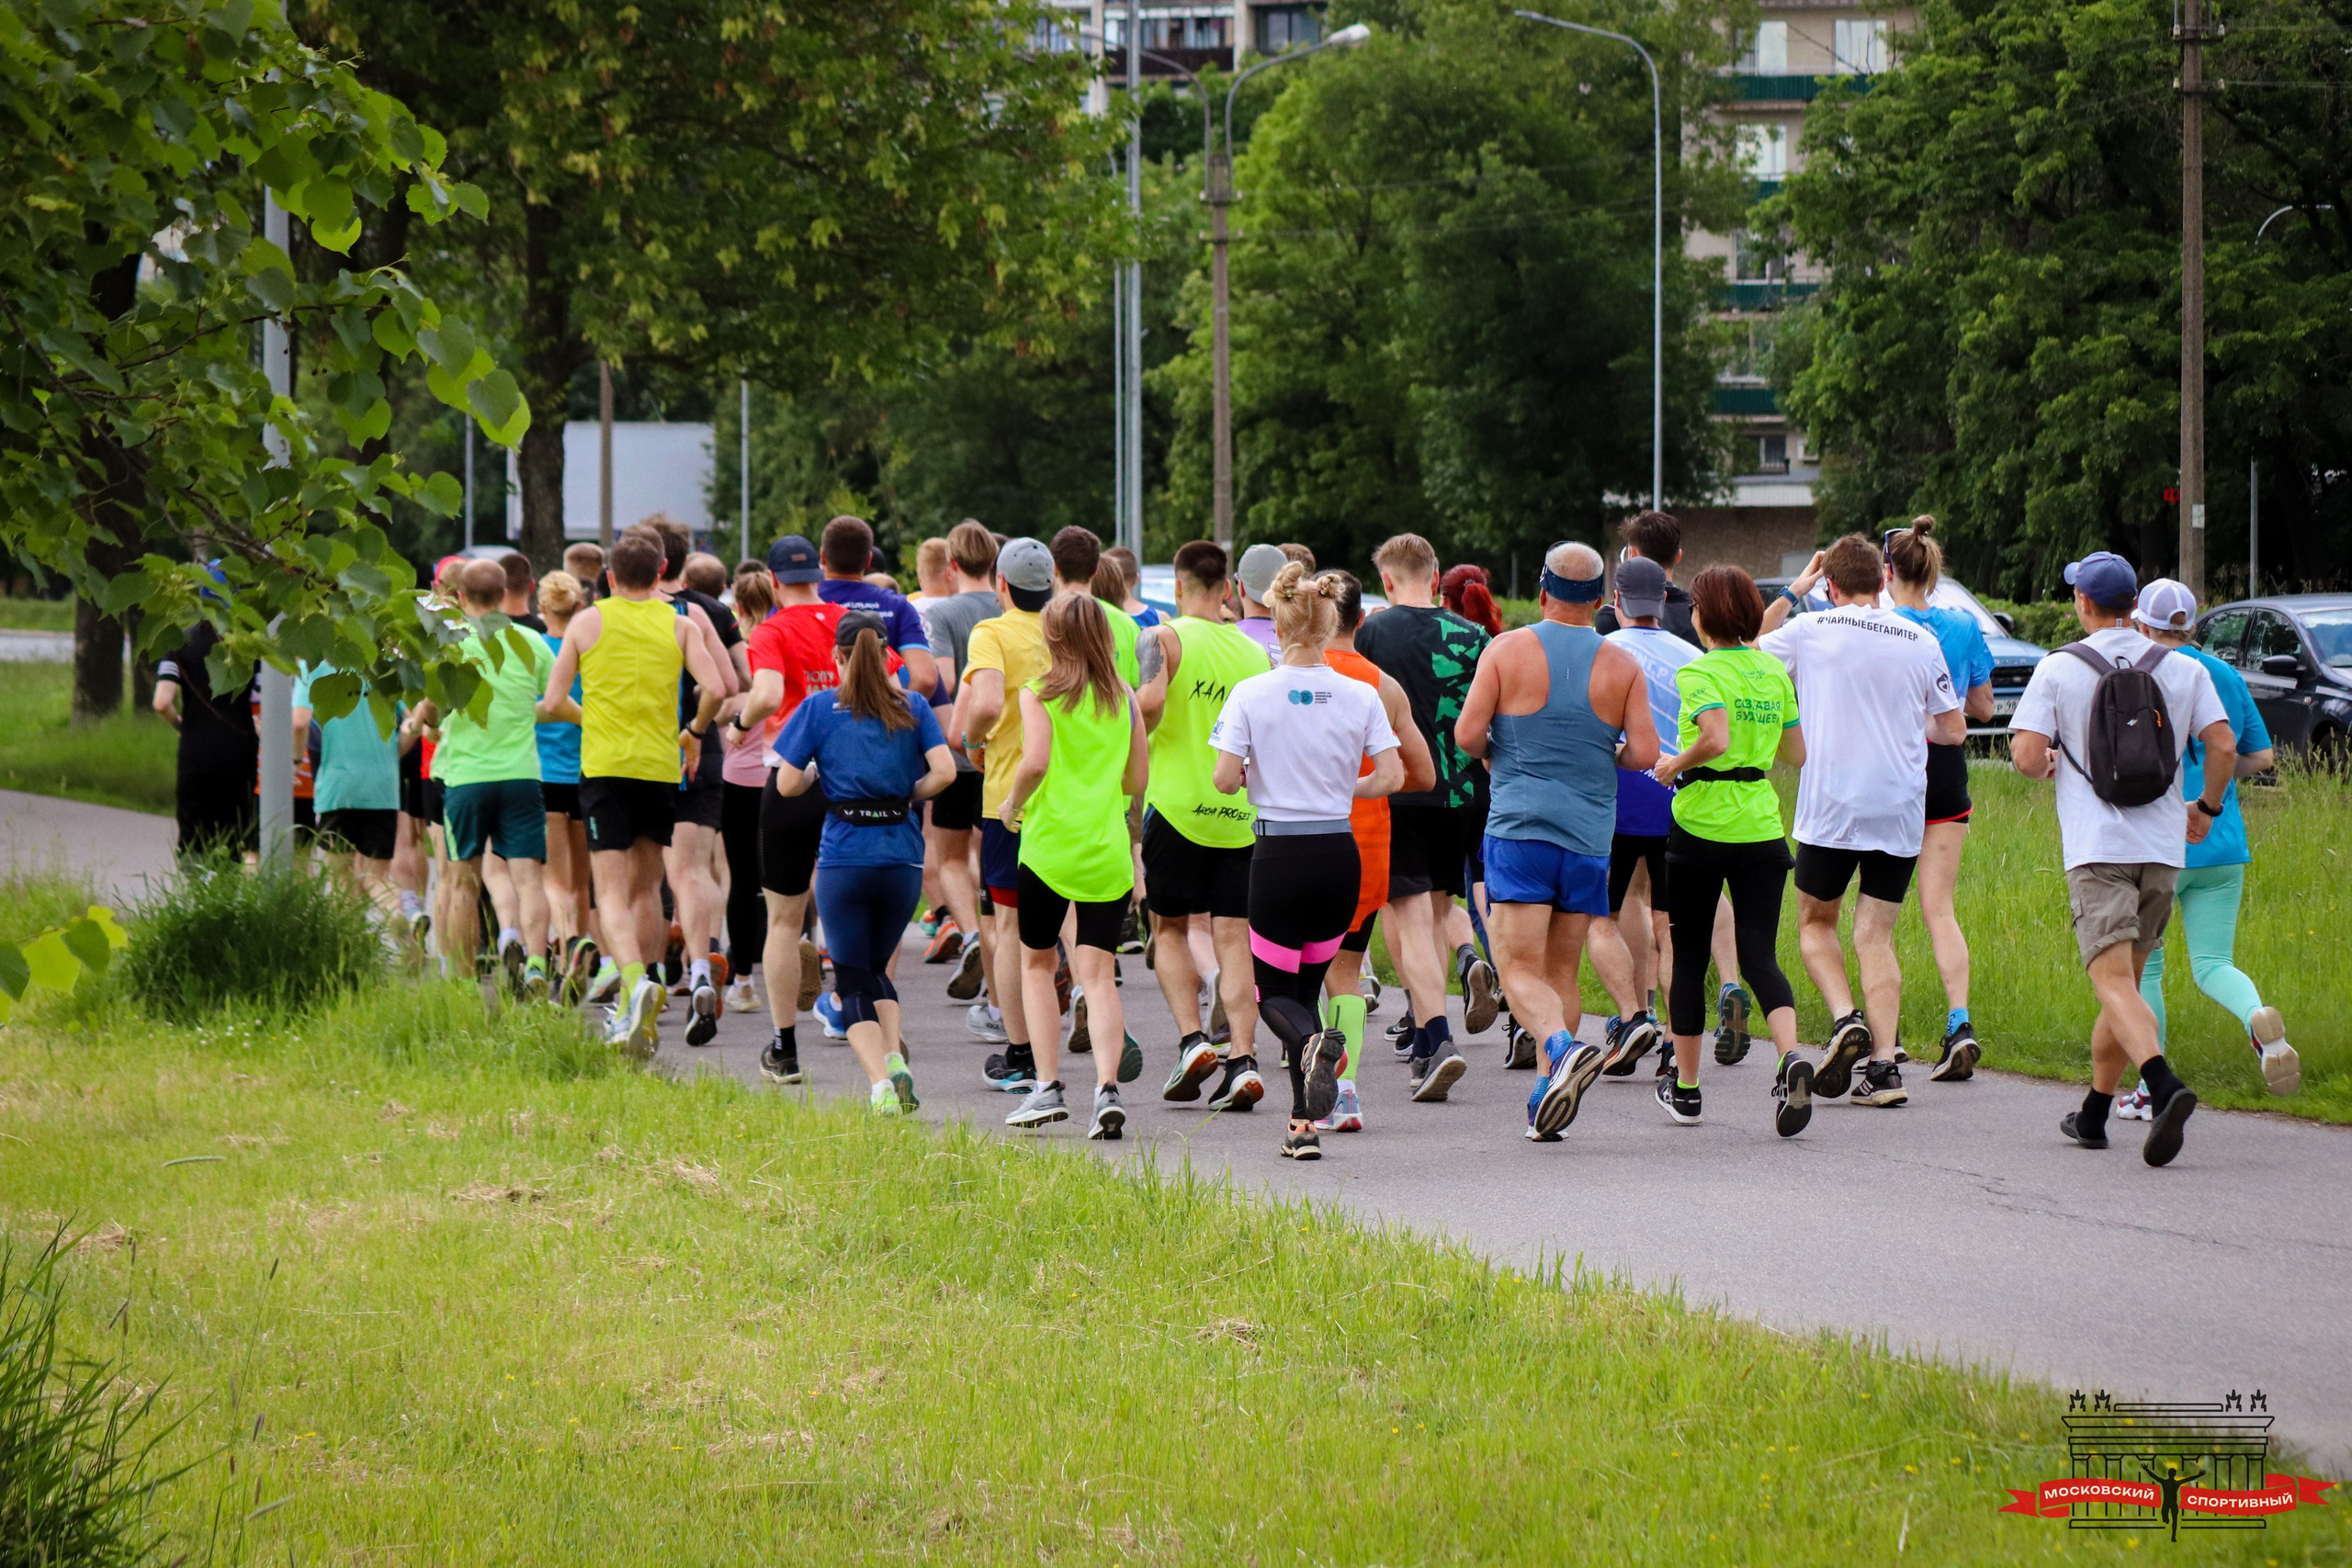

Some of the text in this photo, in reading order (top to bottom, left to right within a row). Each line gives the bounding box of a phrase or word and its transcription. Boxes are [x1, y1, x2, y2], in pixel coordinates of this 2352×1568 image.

[1816, 615, 1918, 641] #ЧАЙНЫЕБЕГАПИТЕР
[1735, 698, 1781, 711] СЗАВАЯ
[1736, 711, 1780, 724] БУДЩЕЕ!
